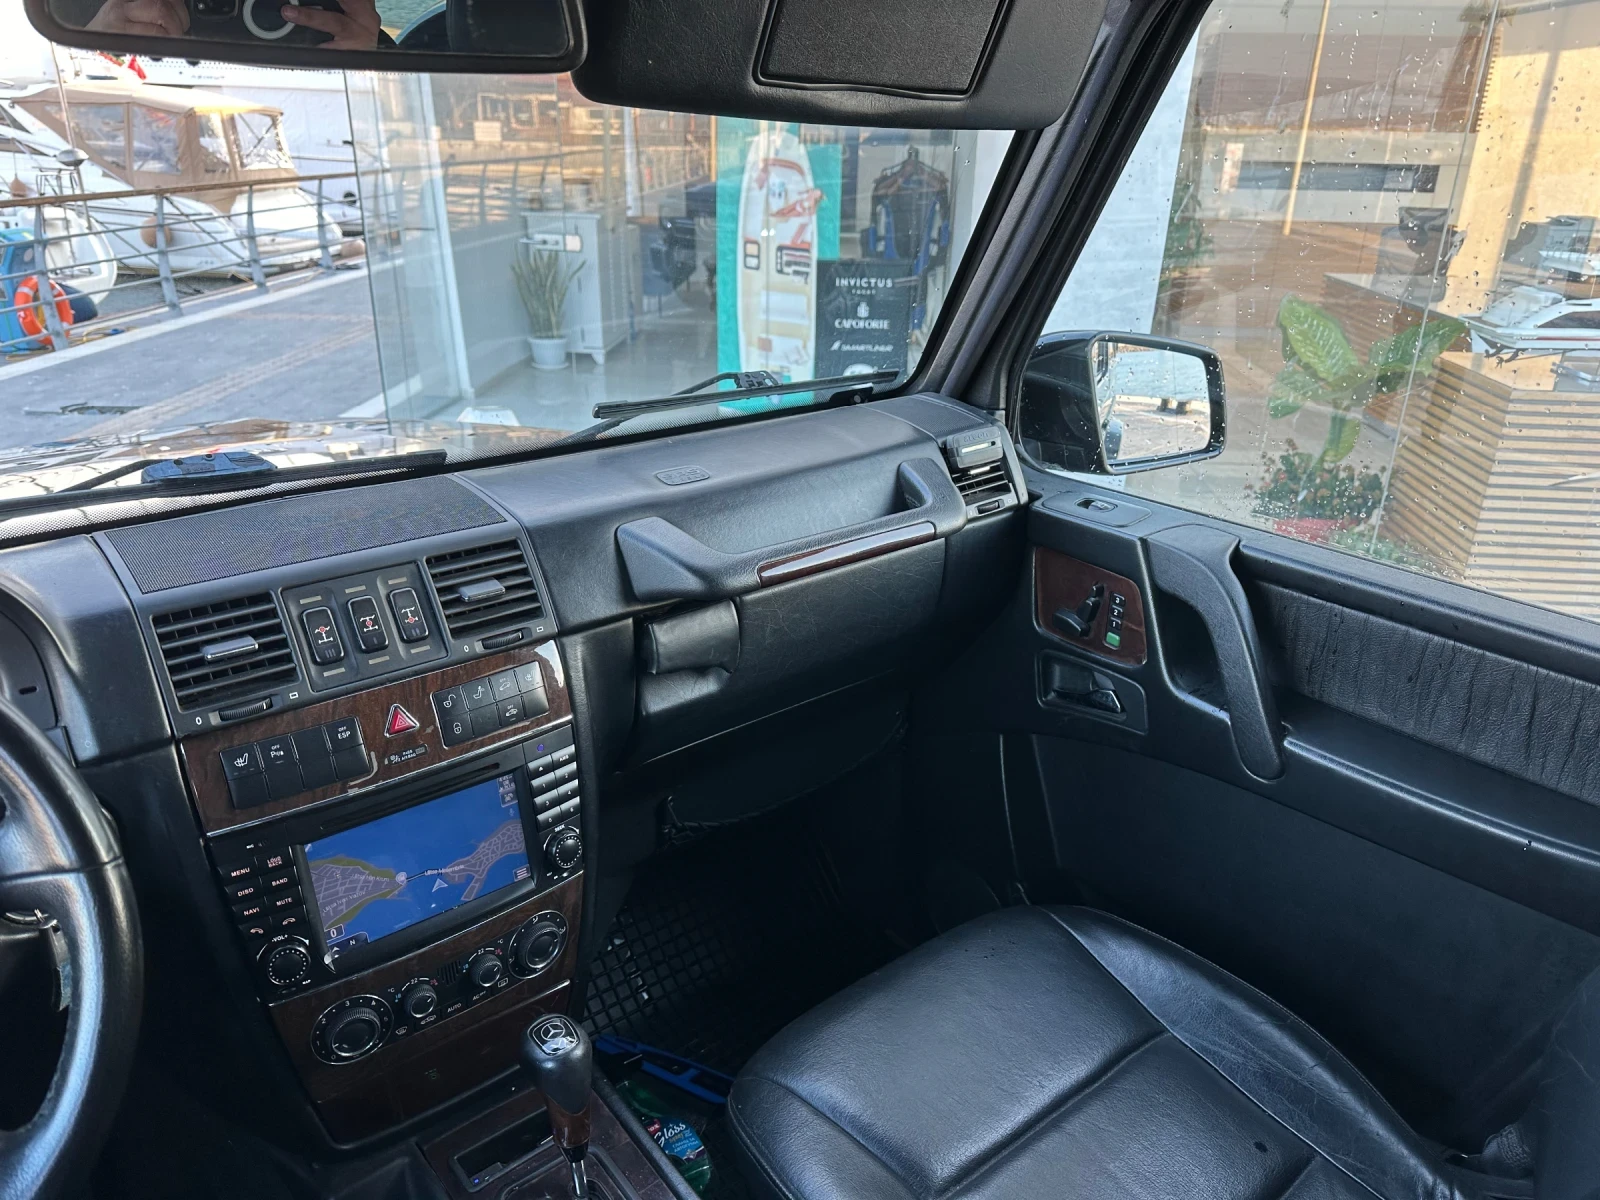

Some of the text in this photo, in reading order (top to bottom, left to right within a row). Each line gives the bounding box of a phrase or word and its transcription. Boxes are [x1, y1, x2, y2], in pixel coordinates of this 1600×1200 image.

[835, 277, 893, 288] INVICTUS
[195, 716, 203, 726] 0
[337, 730, 351, 740] ESP
[230, 867, 250, 877] MENU
[271, 877, 288, 887] BAND
[276, 897, 293, 906] MUTE
[243, 907, 260, 916] NAVI
[330, 928, 337, 938] 0
[447, 1002, 462, 1013] AUTO
